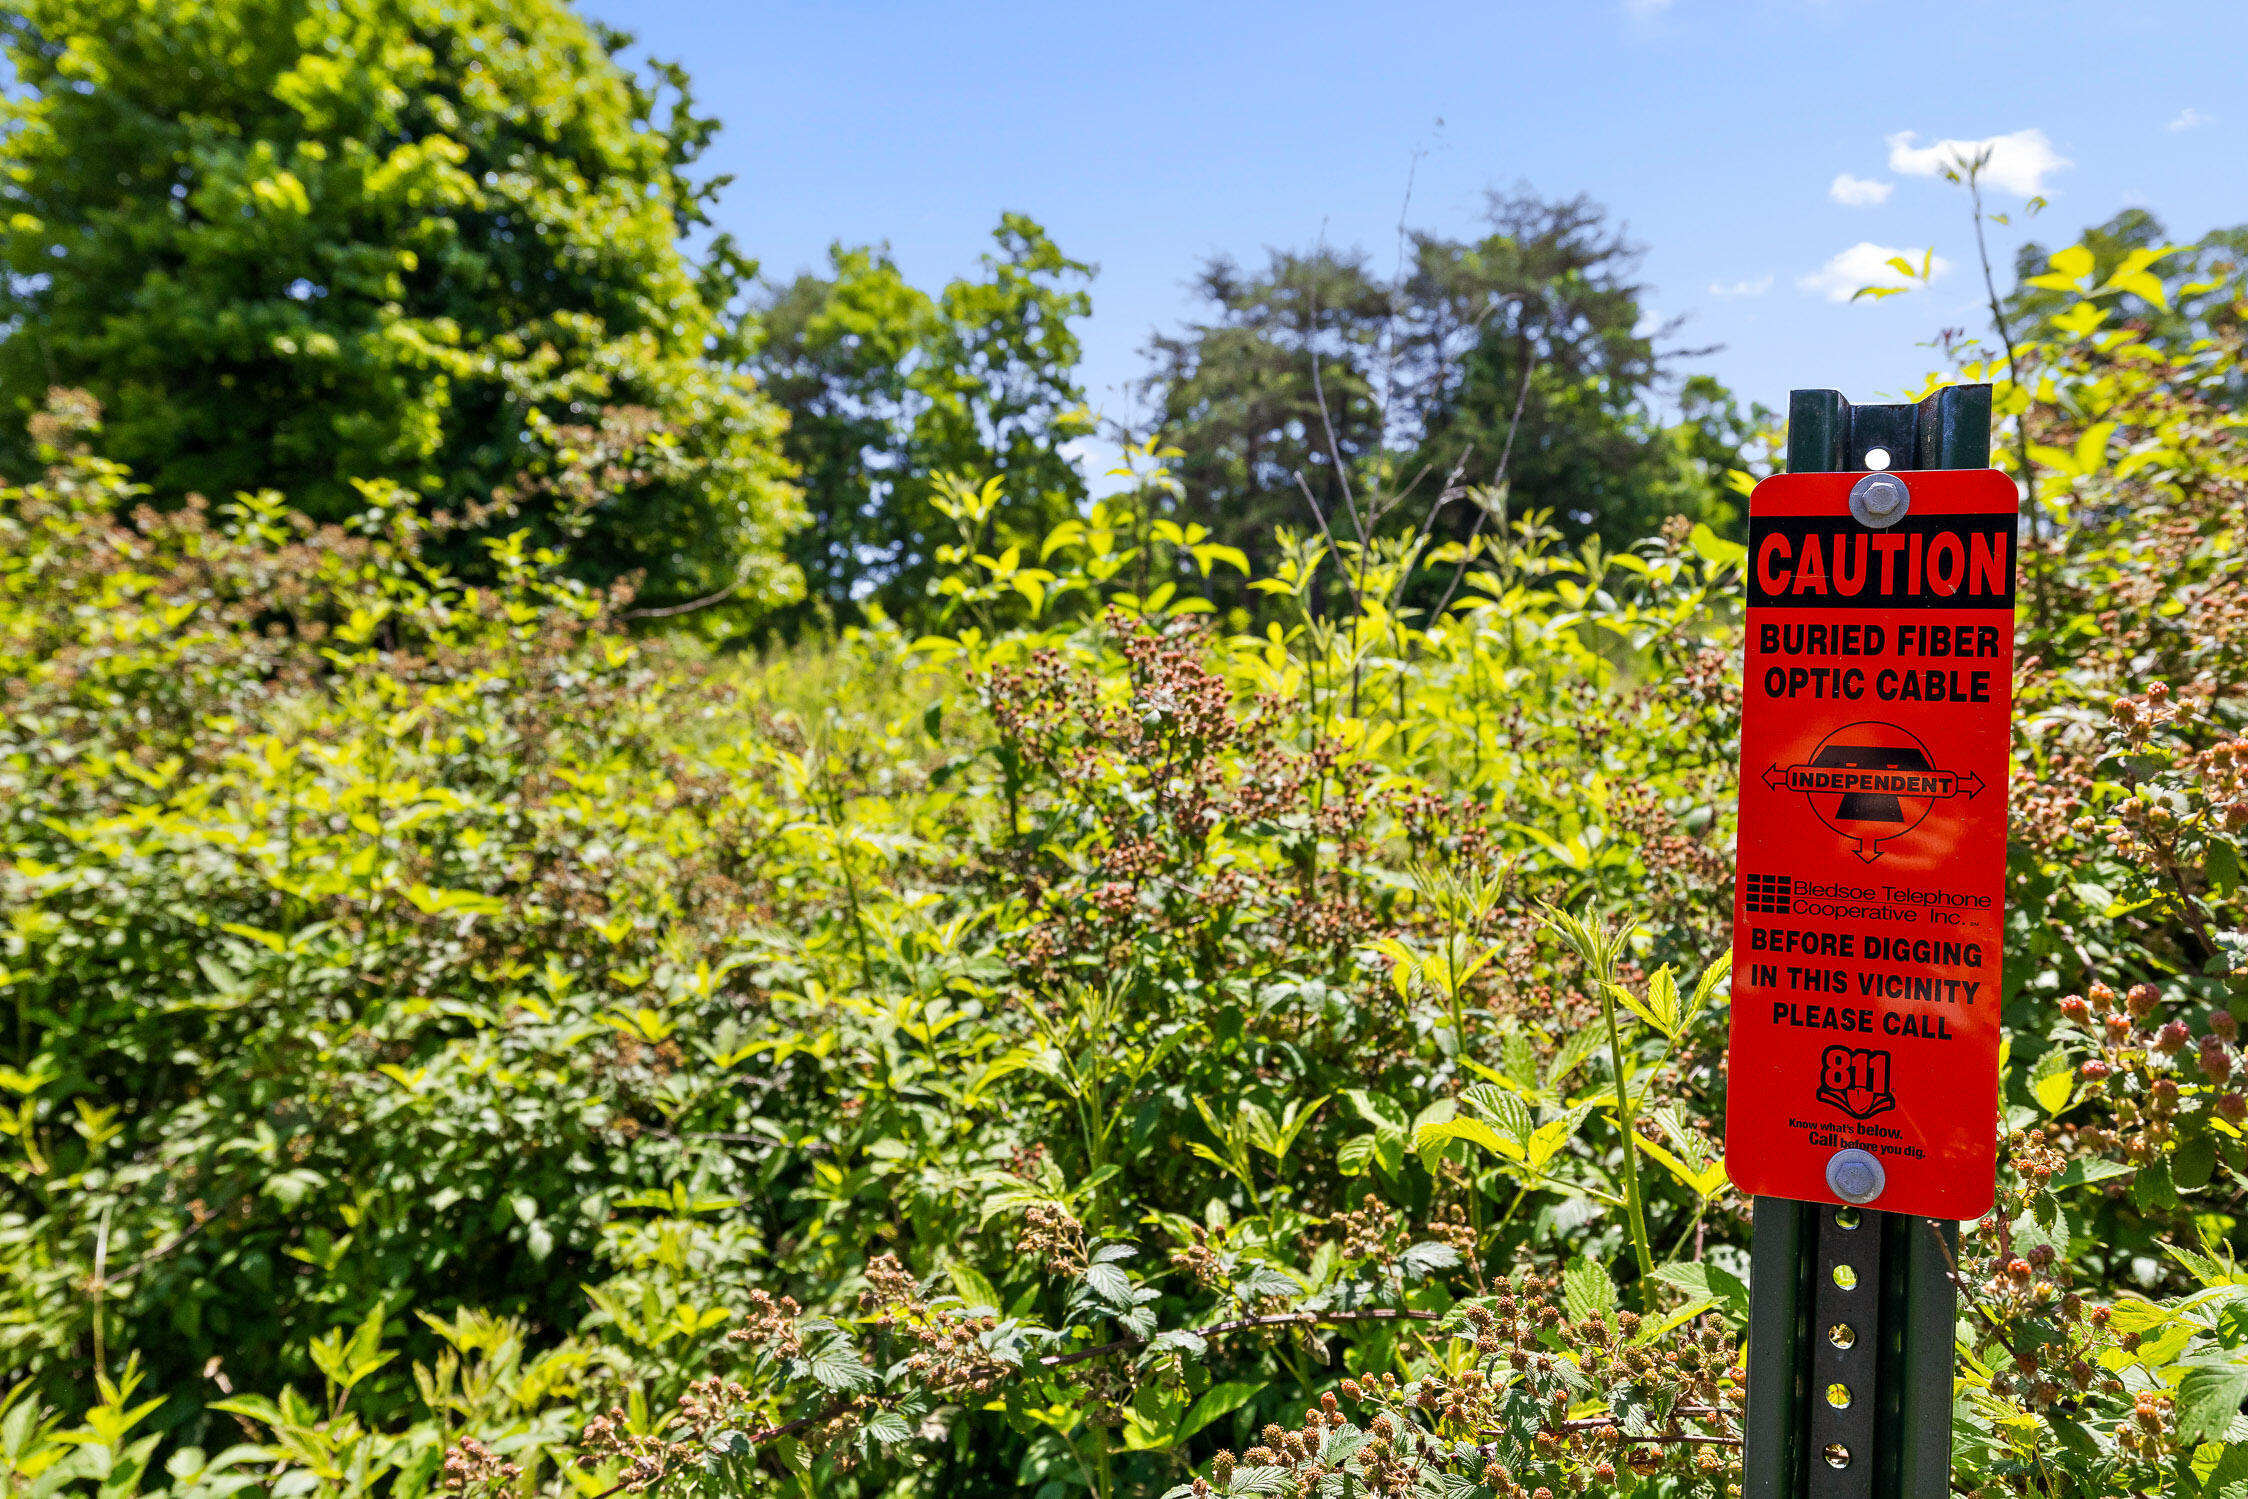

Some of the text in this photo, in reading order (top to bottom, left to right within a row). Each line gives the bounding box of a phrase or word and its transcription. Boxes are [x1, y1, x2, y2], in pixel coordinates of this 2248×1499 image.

[1757, 531, 2007, 597] CAUTION
[1760, 624, 1999, 657] BURIED FIBER
[1764, 667, 1990, 702] OPTIC CABLE
[1791, 772, 1953, 793] INDEPENDENT
[1794, 881, 1991, 908] Bledsoe Telephone
[1793, 900, 1967, 926] Cooperative Inc.
[1752, 928, 1982, 967] BEFORE DIGGING
[1752, 964, 1980, 1005] IN THIS VICINITY
[1773, 1002, 1952, 1040] PLEASE CALL
[1823, 1047, 1888, 1095] 811
[1789, 1118, 1903, 1140] Know what's below.
[1809, 1132, 1926, 1159] Call before you dig.
